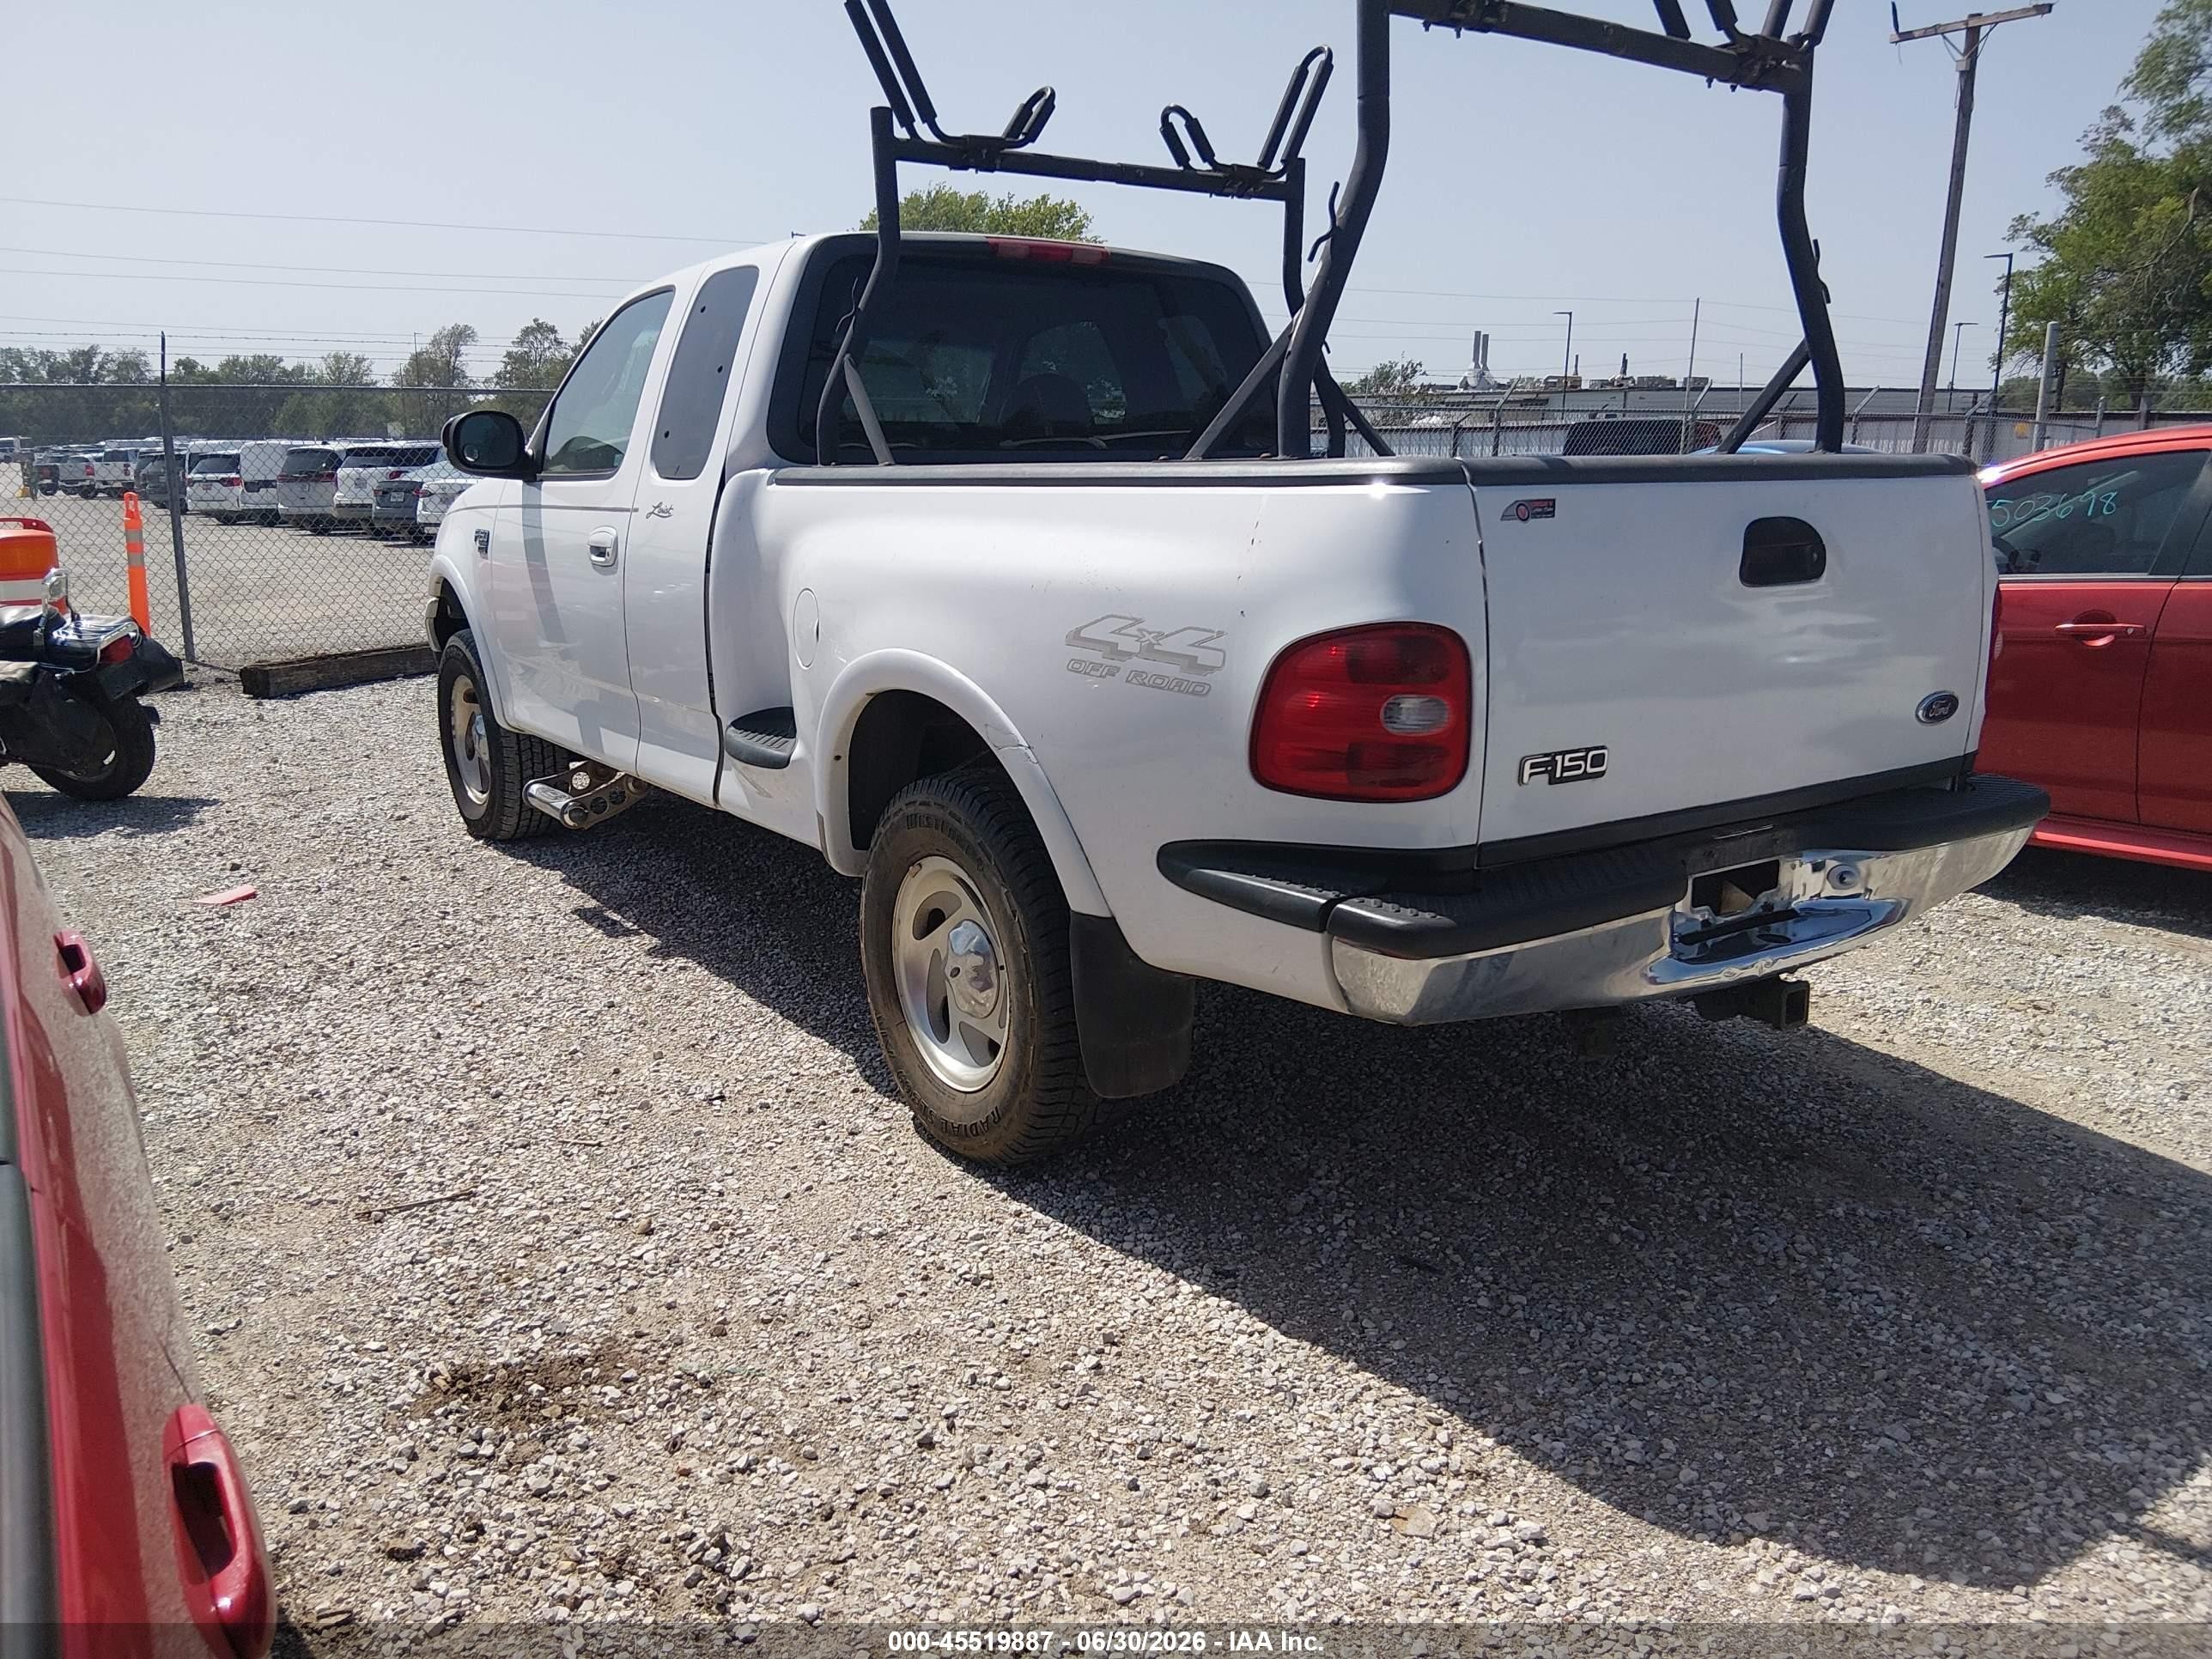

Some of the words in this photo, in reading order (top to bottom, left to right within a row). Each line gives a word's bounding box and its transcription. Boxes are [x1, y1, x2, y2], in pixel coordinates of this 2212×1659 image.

[1986, 491, 2118, 527] 503698
[1066, 659, 1121, 678] OFF
[1125, 670, 1212, 697] ROAD
[1519, 746, 1608, 786] F-150
[940, 1105, 1001, 1138] RADIAL
